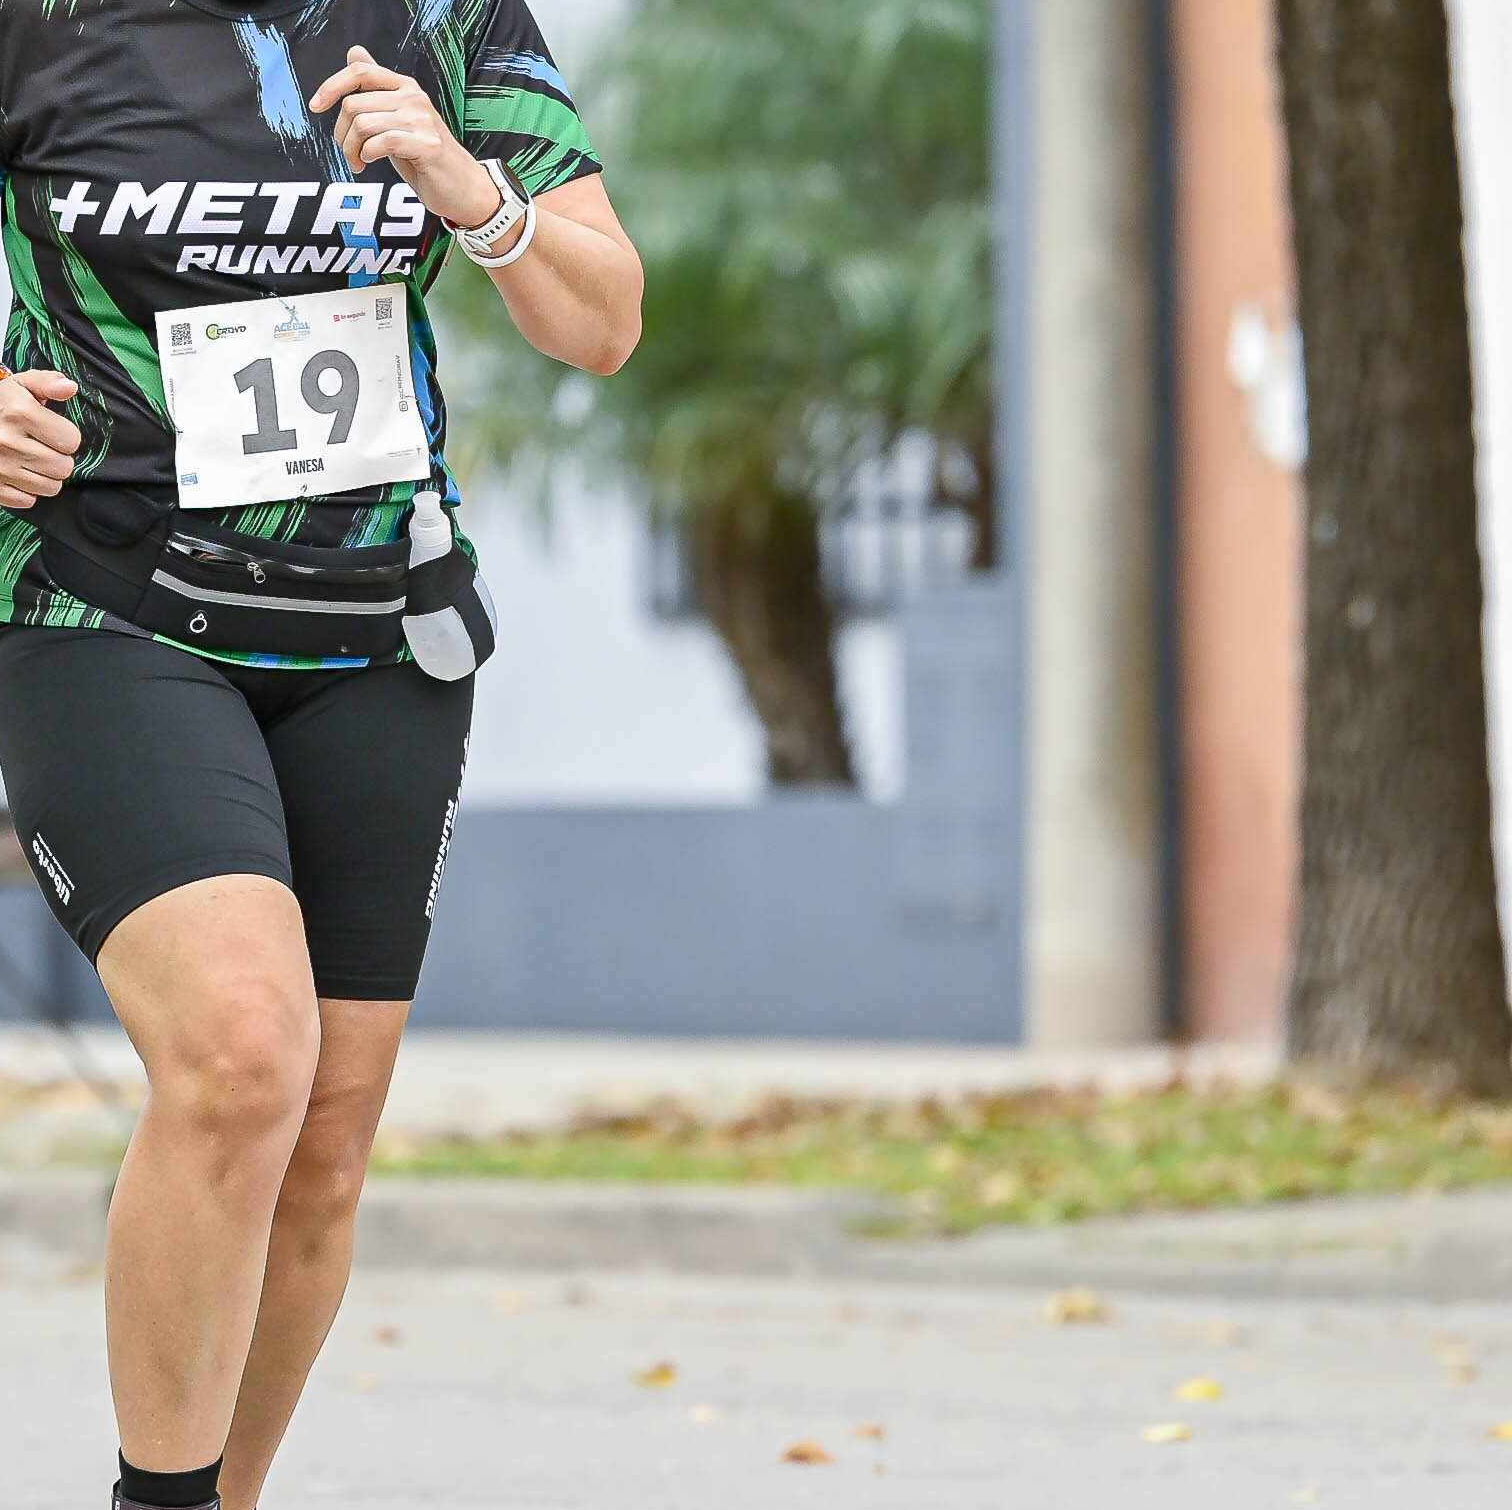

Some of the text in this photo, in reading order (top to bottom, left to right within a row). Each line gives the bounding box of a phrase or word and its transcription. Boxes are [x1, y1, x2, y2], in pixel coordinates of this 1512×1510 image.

[49, 181, 426, 236] +METAS
[176, 245, 417, 275] RUNNING
[233, 349, 360, 455] 19
[285, 457, 325, 476] VANESA
[425, 799, 454, 919] RUNNING
